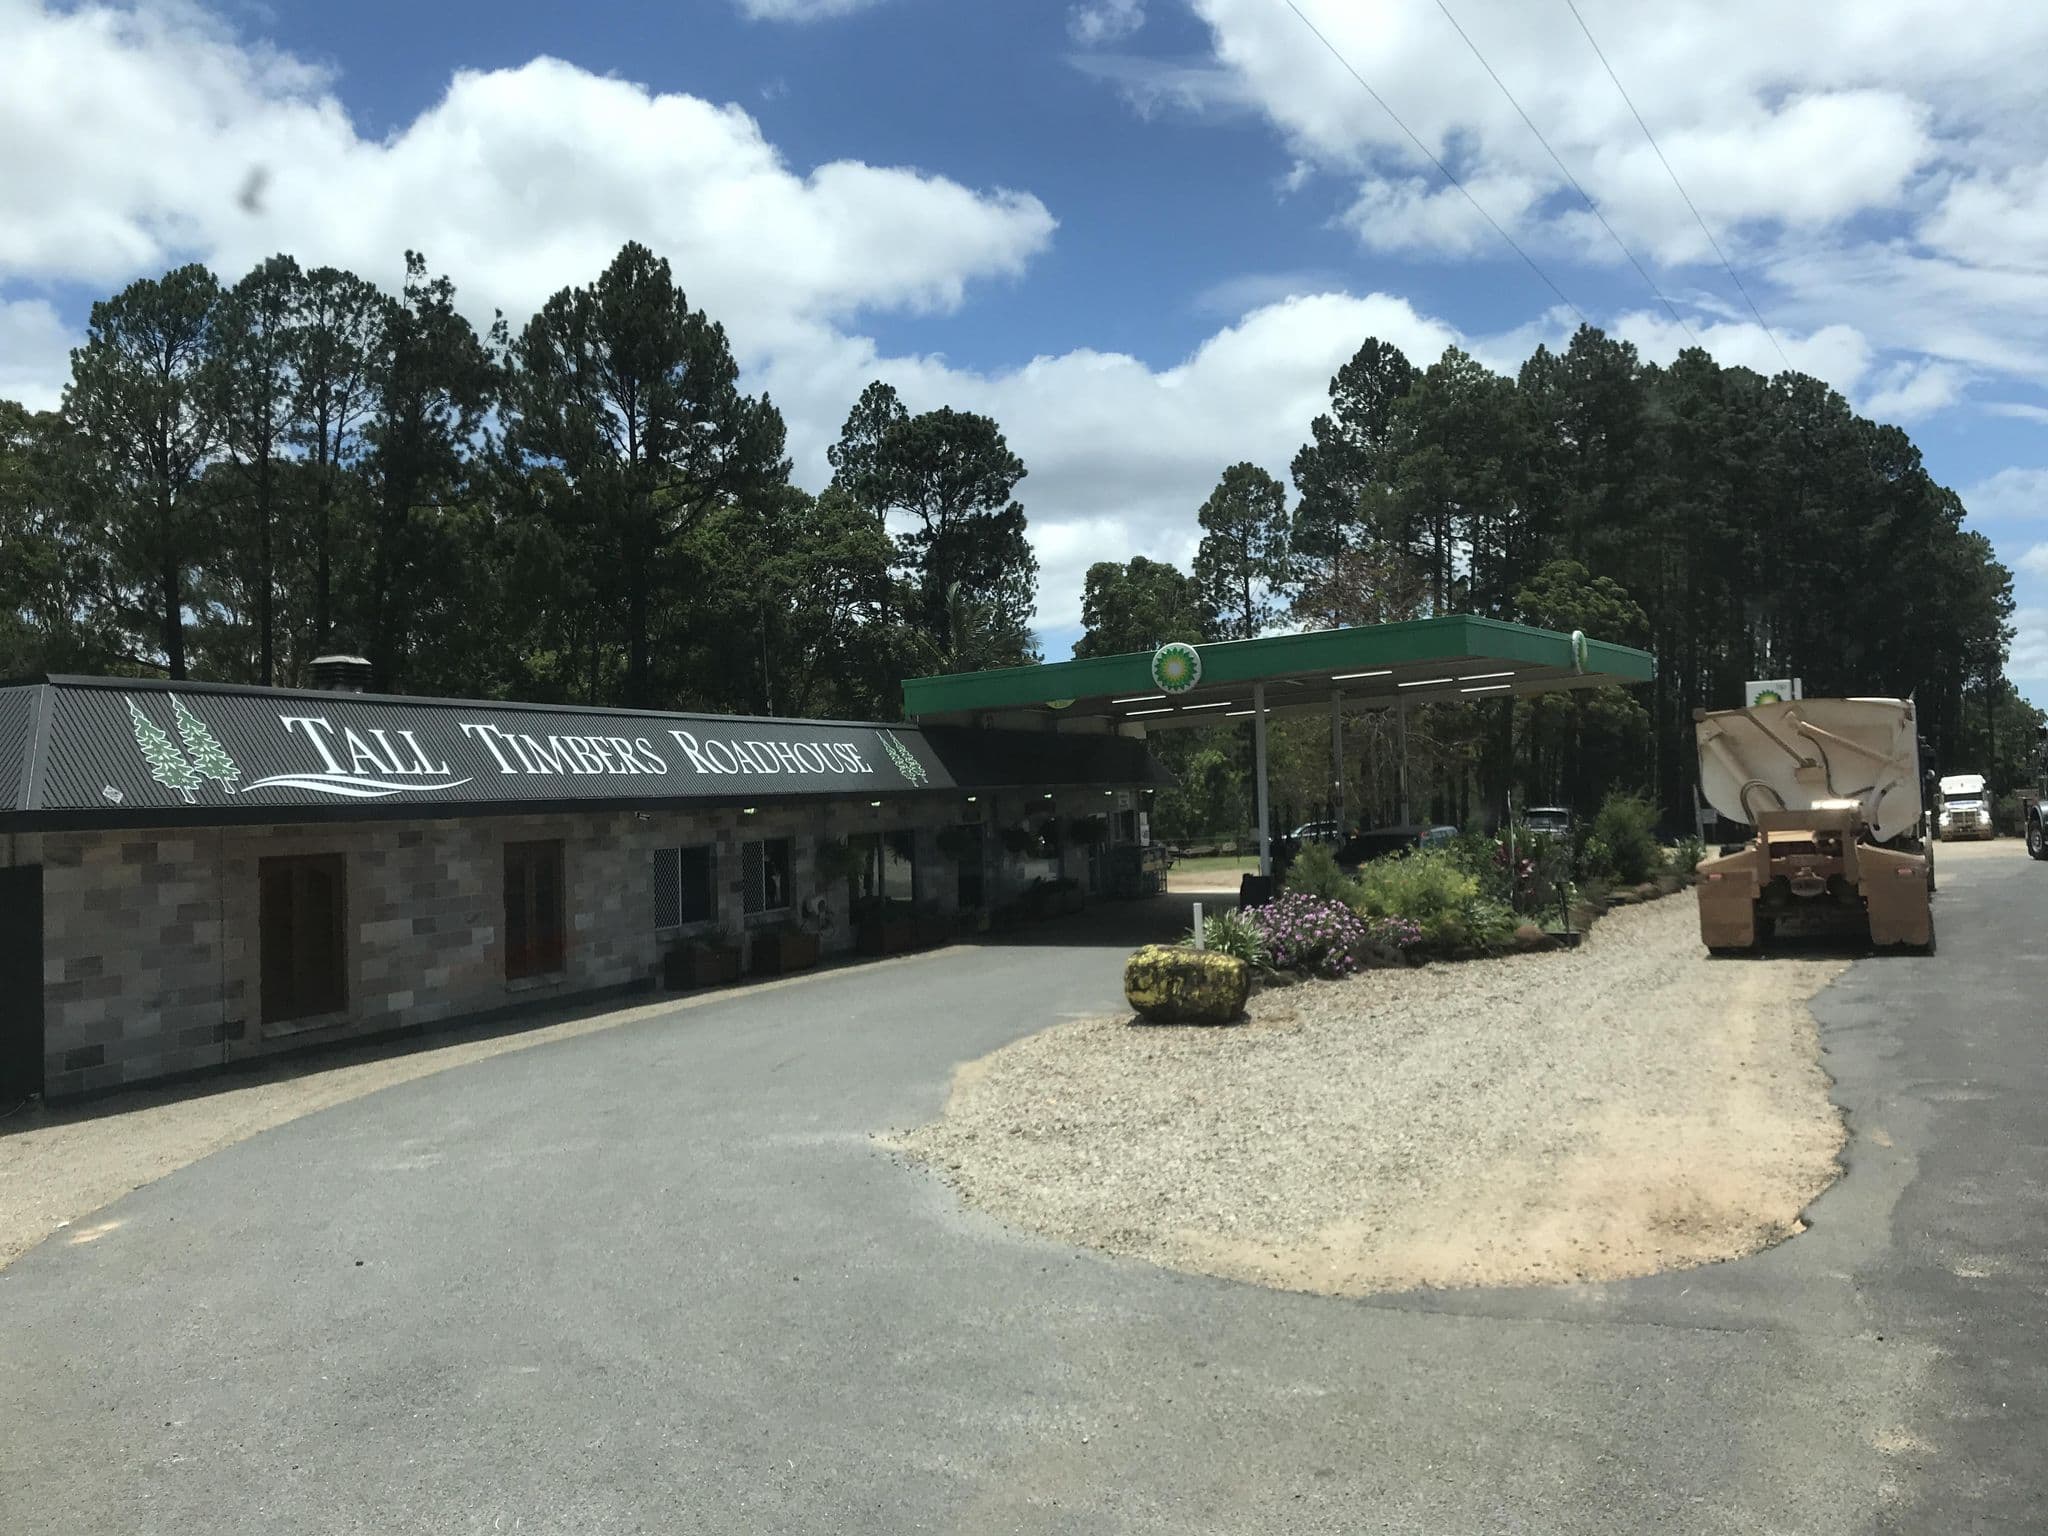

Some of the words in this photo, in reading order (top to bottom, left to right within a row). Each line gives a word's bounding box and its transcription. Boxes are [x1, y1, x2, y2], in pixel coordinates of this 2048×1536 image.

[279, 715, 450, 776] TALL
[458, 722, 668, 775] TIMBERS
[667, 730, 874, 774] ROADHOUSE
